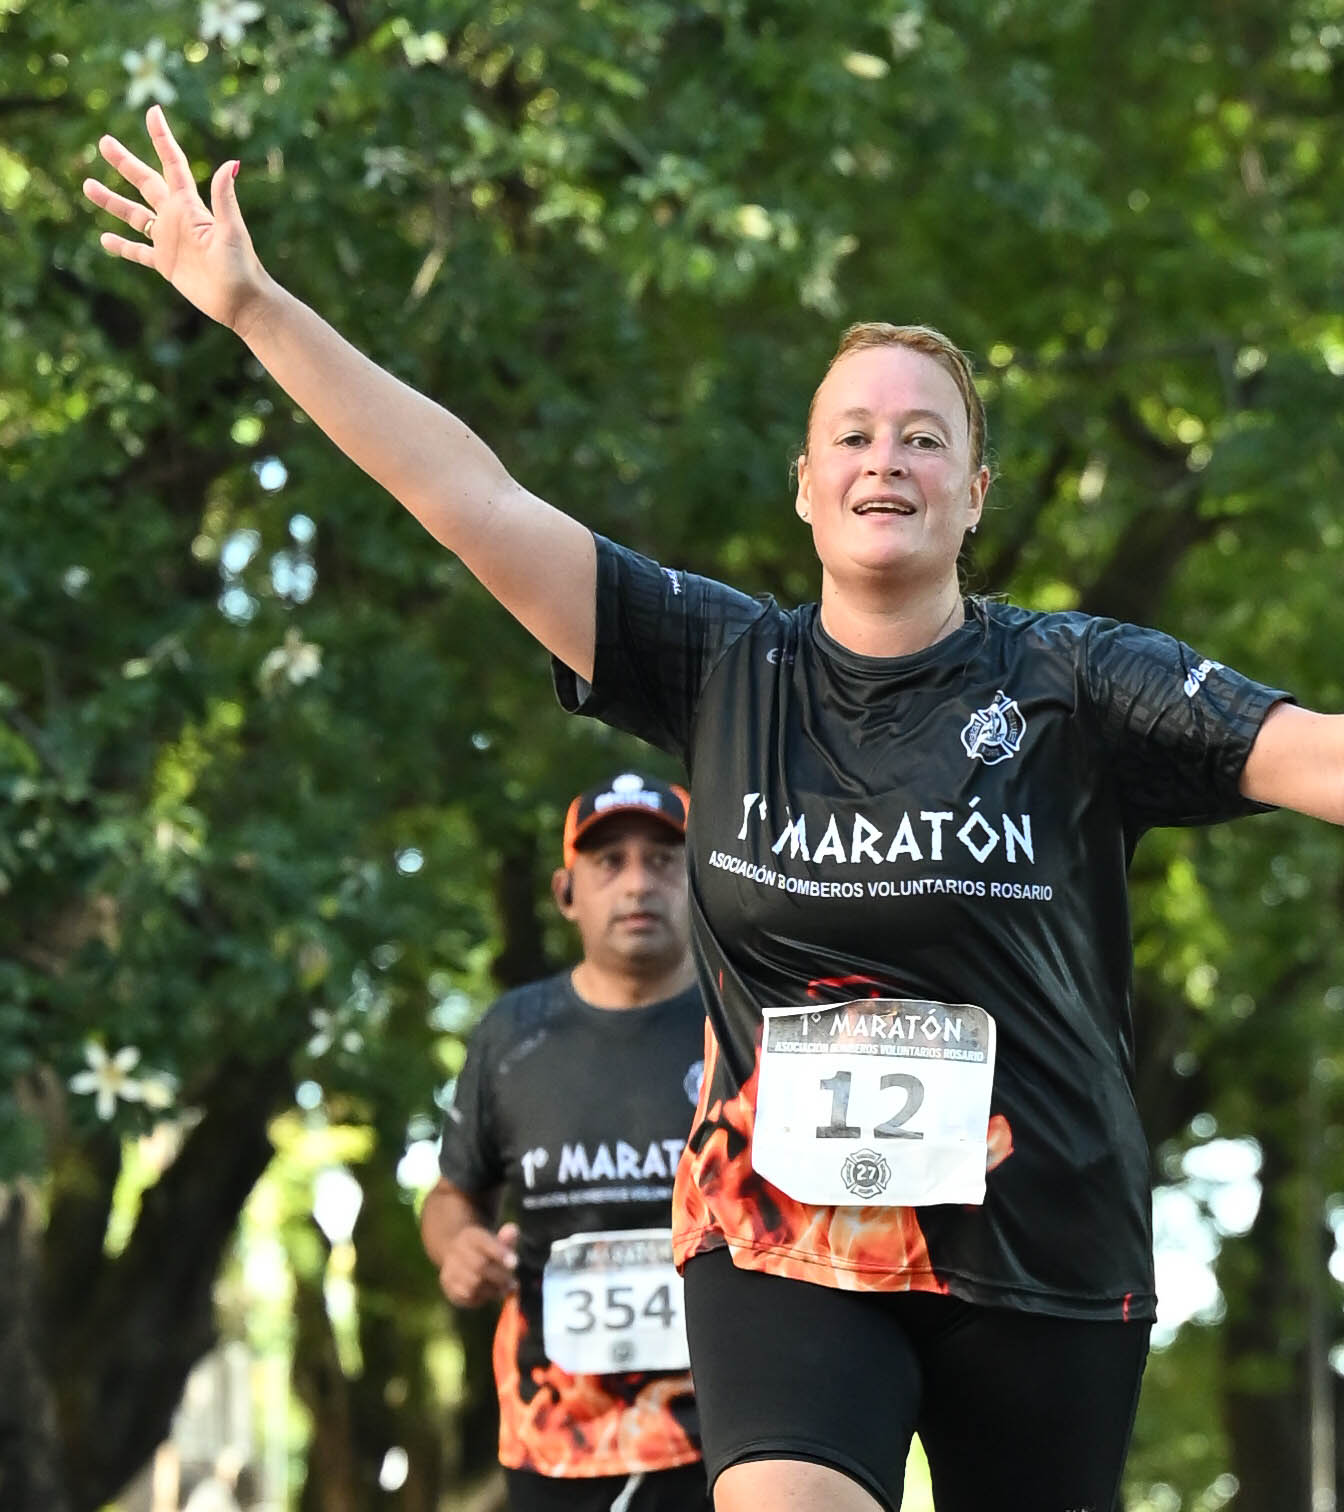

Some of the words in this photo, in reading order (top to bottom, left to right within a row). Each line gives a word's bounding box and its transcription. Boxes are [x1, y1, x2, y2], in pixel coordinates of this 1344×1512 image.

[771, 795, 1035, 865] MARATÓN
[708, 849, 776, 887] ASOCIACIÓN
[777, 873, 864, 899] BOMBEROS
[867, 878, 986, 898] VOLUNTARIOS
[989, 880, 1053, 901] ROSARIO
[829, 1008, 962, 1042] MARATÓN
[880, 1045, 942, 1059] VOLUNTARIOS
[943, 1048, 984, 1063] ROSARIO
[815, 1070, 925, 1140] 12
[856, 1163, 877, 1181] 27
[564, 1284, 677, 1335] 354
